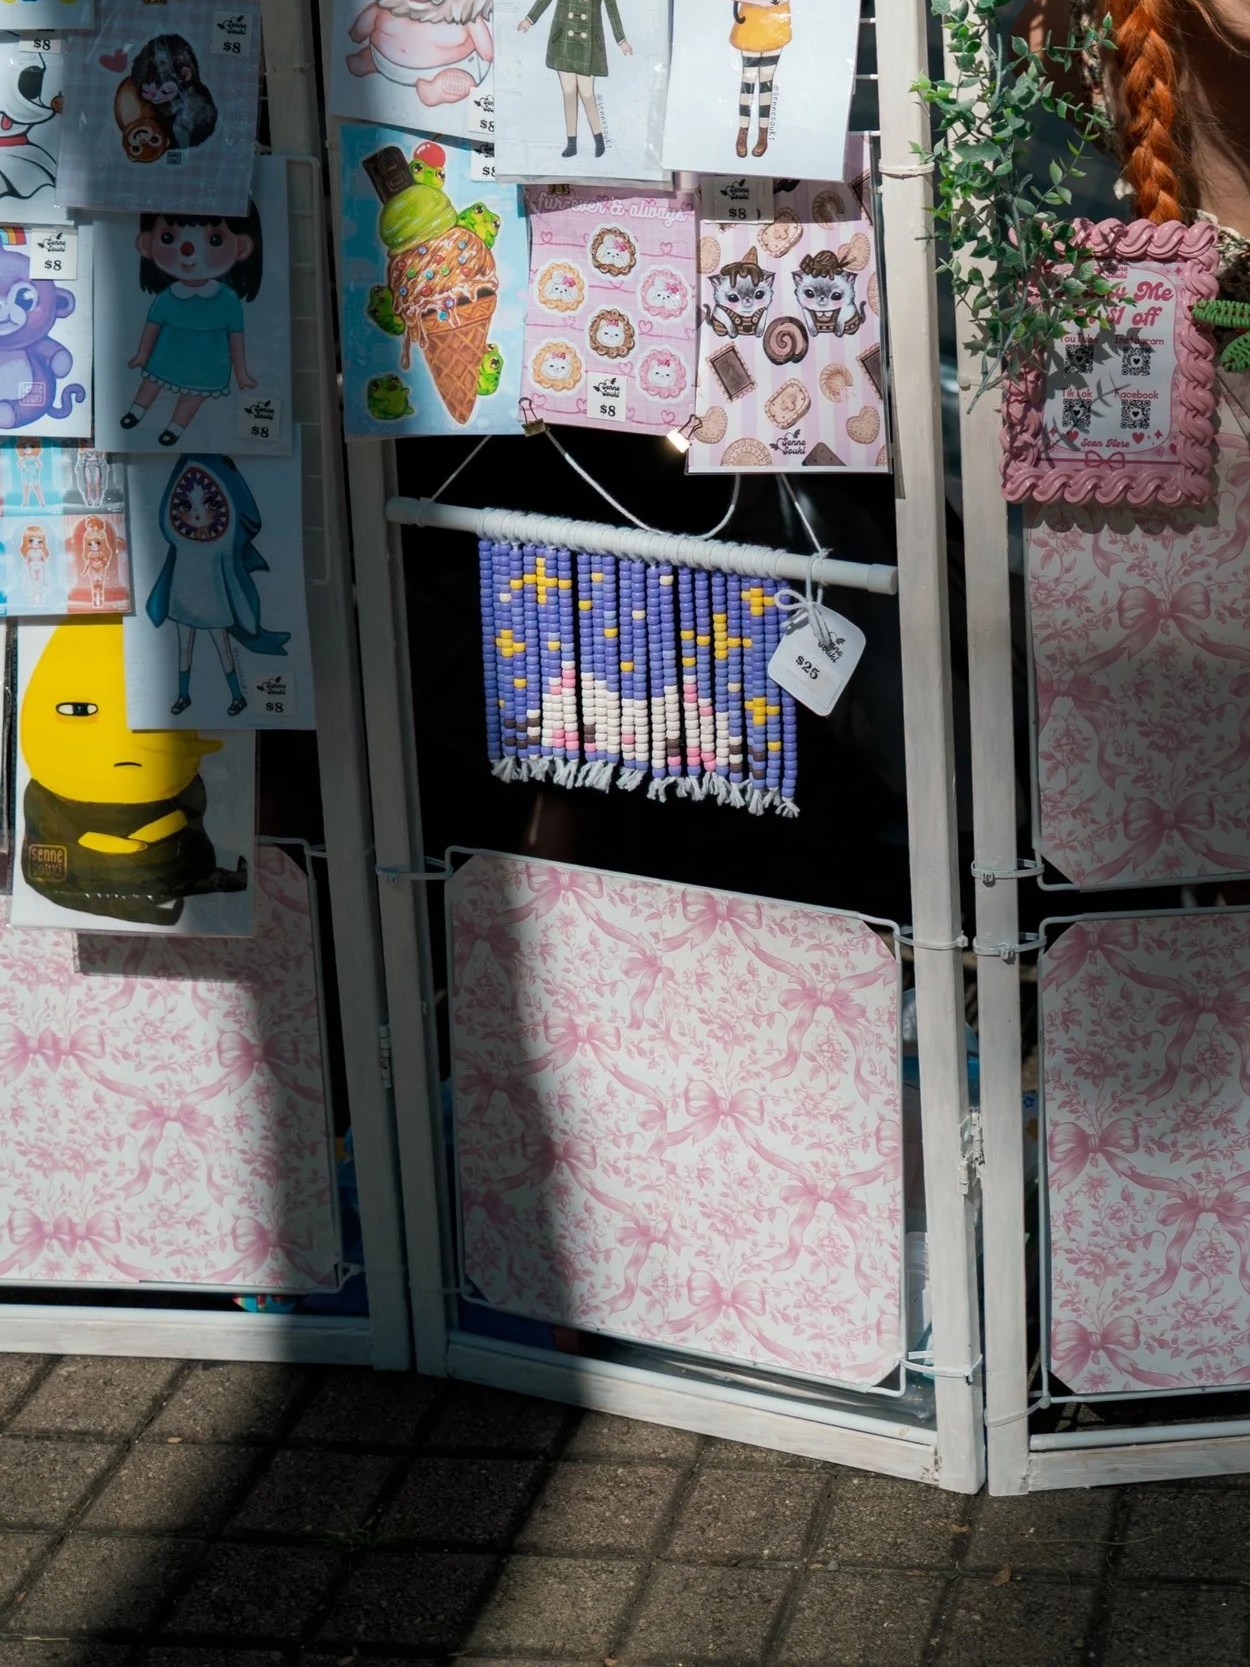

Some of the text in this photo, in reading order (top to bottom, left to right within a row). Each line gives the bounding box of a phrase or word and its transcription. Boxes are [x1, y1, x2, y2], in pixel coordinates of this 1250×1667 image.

[33, 38, 51, 50] $8
[223, 42, 241, 53] $8
[629, 200, 690, 226] always
[728, 208, 747, 219] $8
[44, 259, 62, 271] $8
[1133, 280, 1175, 302] Me
[1131, 306, 1163, 327] off
[1114, 334, 1165, 346] Instagram
[1114, 389, 1159, 400] Facebook
[600, 405, 616, 417] $8
[251, 426, 269, 438] $8
[796, 655, 820, 680] $25
[266, 702, 283, 713] $8
